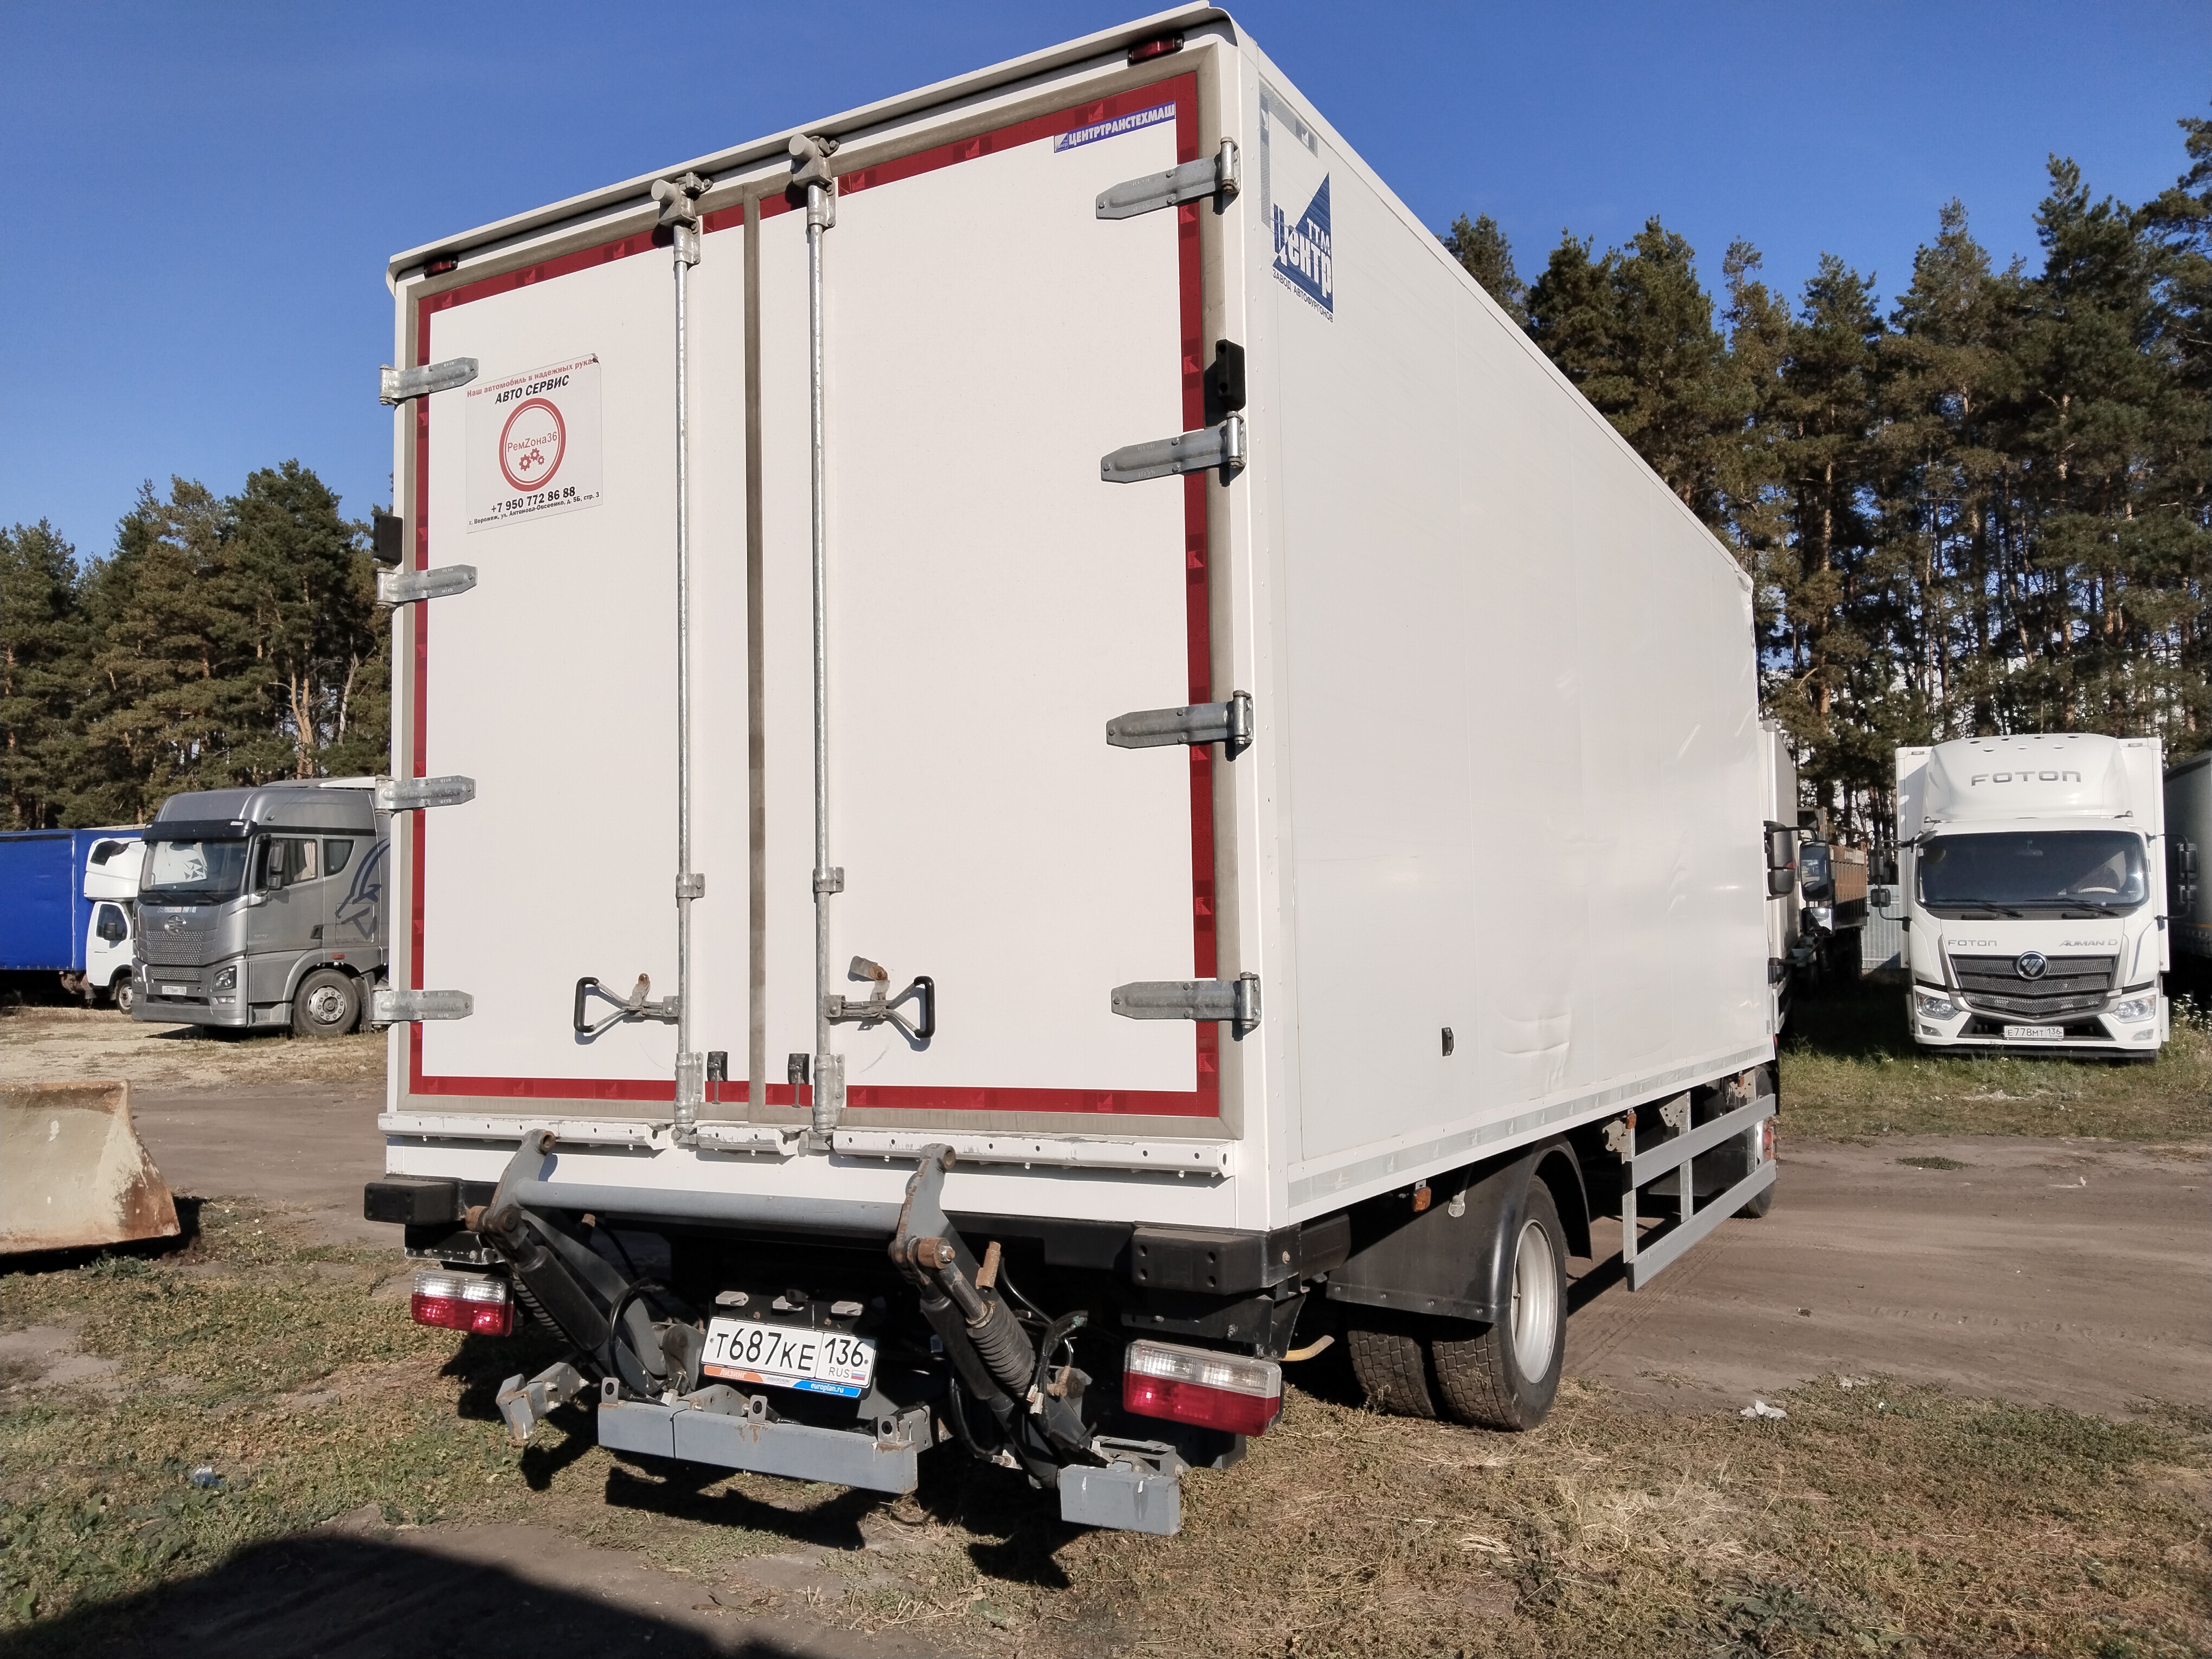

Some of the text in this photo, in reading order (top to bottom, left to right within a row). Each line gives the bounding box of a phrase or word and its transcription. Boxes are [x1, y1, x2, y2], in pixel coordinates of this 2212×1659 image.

[1069, 104, 1175, 146] ЦЕНТРТРАНСТЕХМАШ
[1274, 202, 1332, 299] Центр
[1307, 217, 1331, 256] ТТМ
[1272, 269, 1333, 324] ЗАВОД АВТОФУРГОНОВ
[467, 388, 482, 397] Наш
[484, 378, 526, 393] автомобиль
[535, 364, 573, 380] надежных
[495, 375, 570, 404] АВТО СЕРВИС
[507, 431, 558, 452] РемZона36
[491, 486, 575, 513] +7 950 772 86 88
[1971, 770, 2081, 787] FOTON
[2059, 939, 2105, 947] AUMAN
[717, 1328, 864, 1371] Т687КЕ 136
[719, 1368, 747, 1380] ЛИЗИНГ
[828, 1367, 850, 1378] RUS
[811, 1383, 844, 1393] europlan.ru
